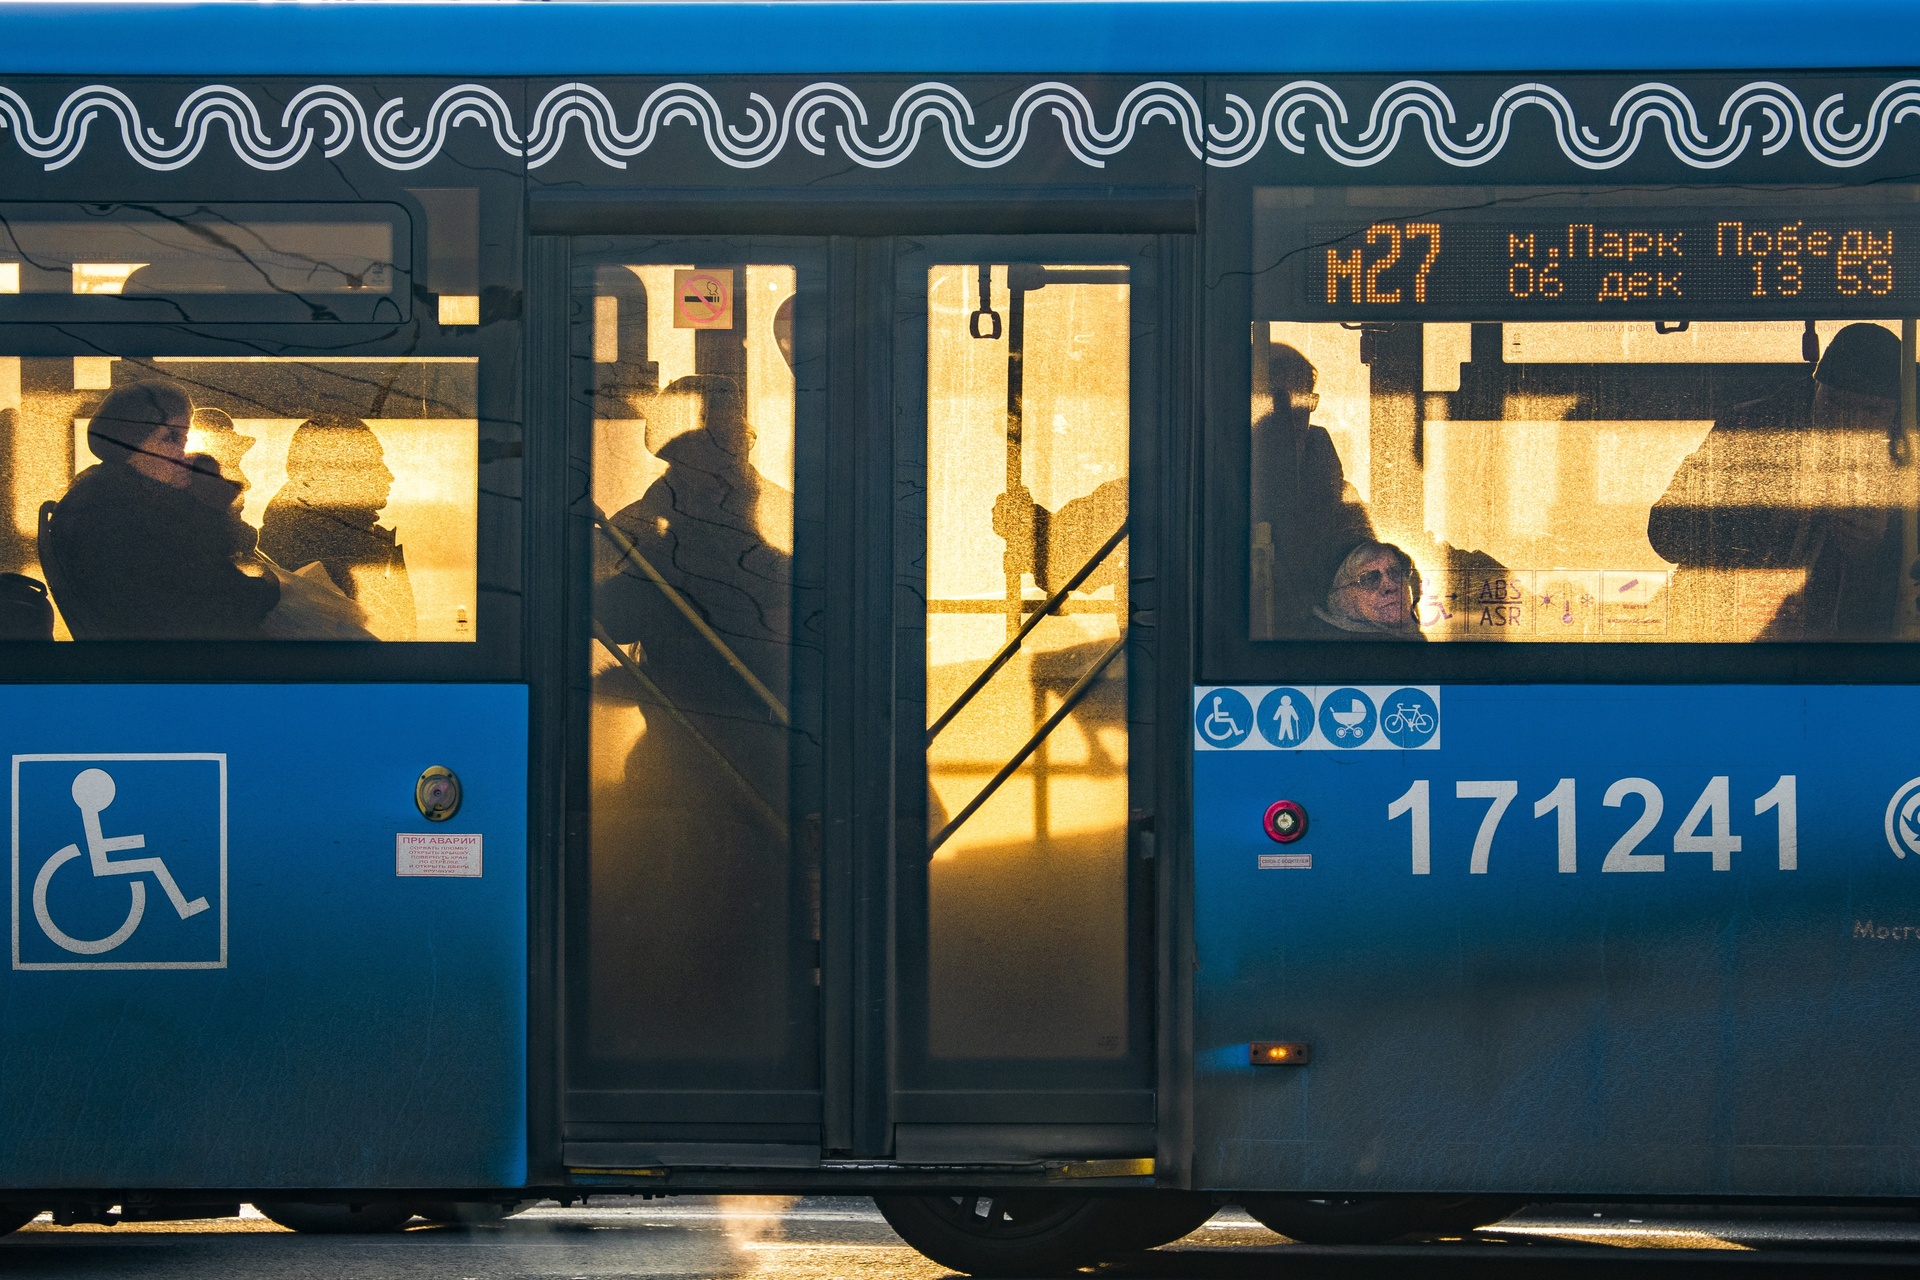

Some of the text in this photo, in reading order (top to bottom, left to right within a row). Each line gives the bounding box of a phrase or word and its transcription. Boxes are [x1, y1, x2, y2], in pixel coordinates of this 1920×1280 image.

[1717, 219, 1894, 260] Победы
[1509, 259, 1894, 302] 06 дек 13 59
[1480, 579, 1521, 600] ABS
[1480, 606, 1521, 626] ASR
[1388, 774, 1797, 875] 171241
[429, 837, 476, 845] АВАРИИ
